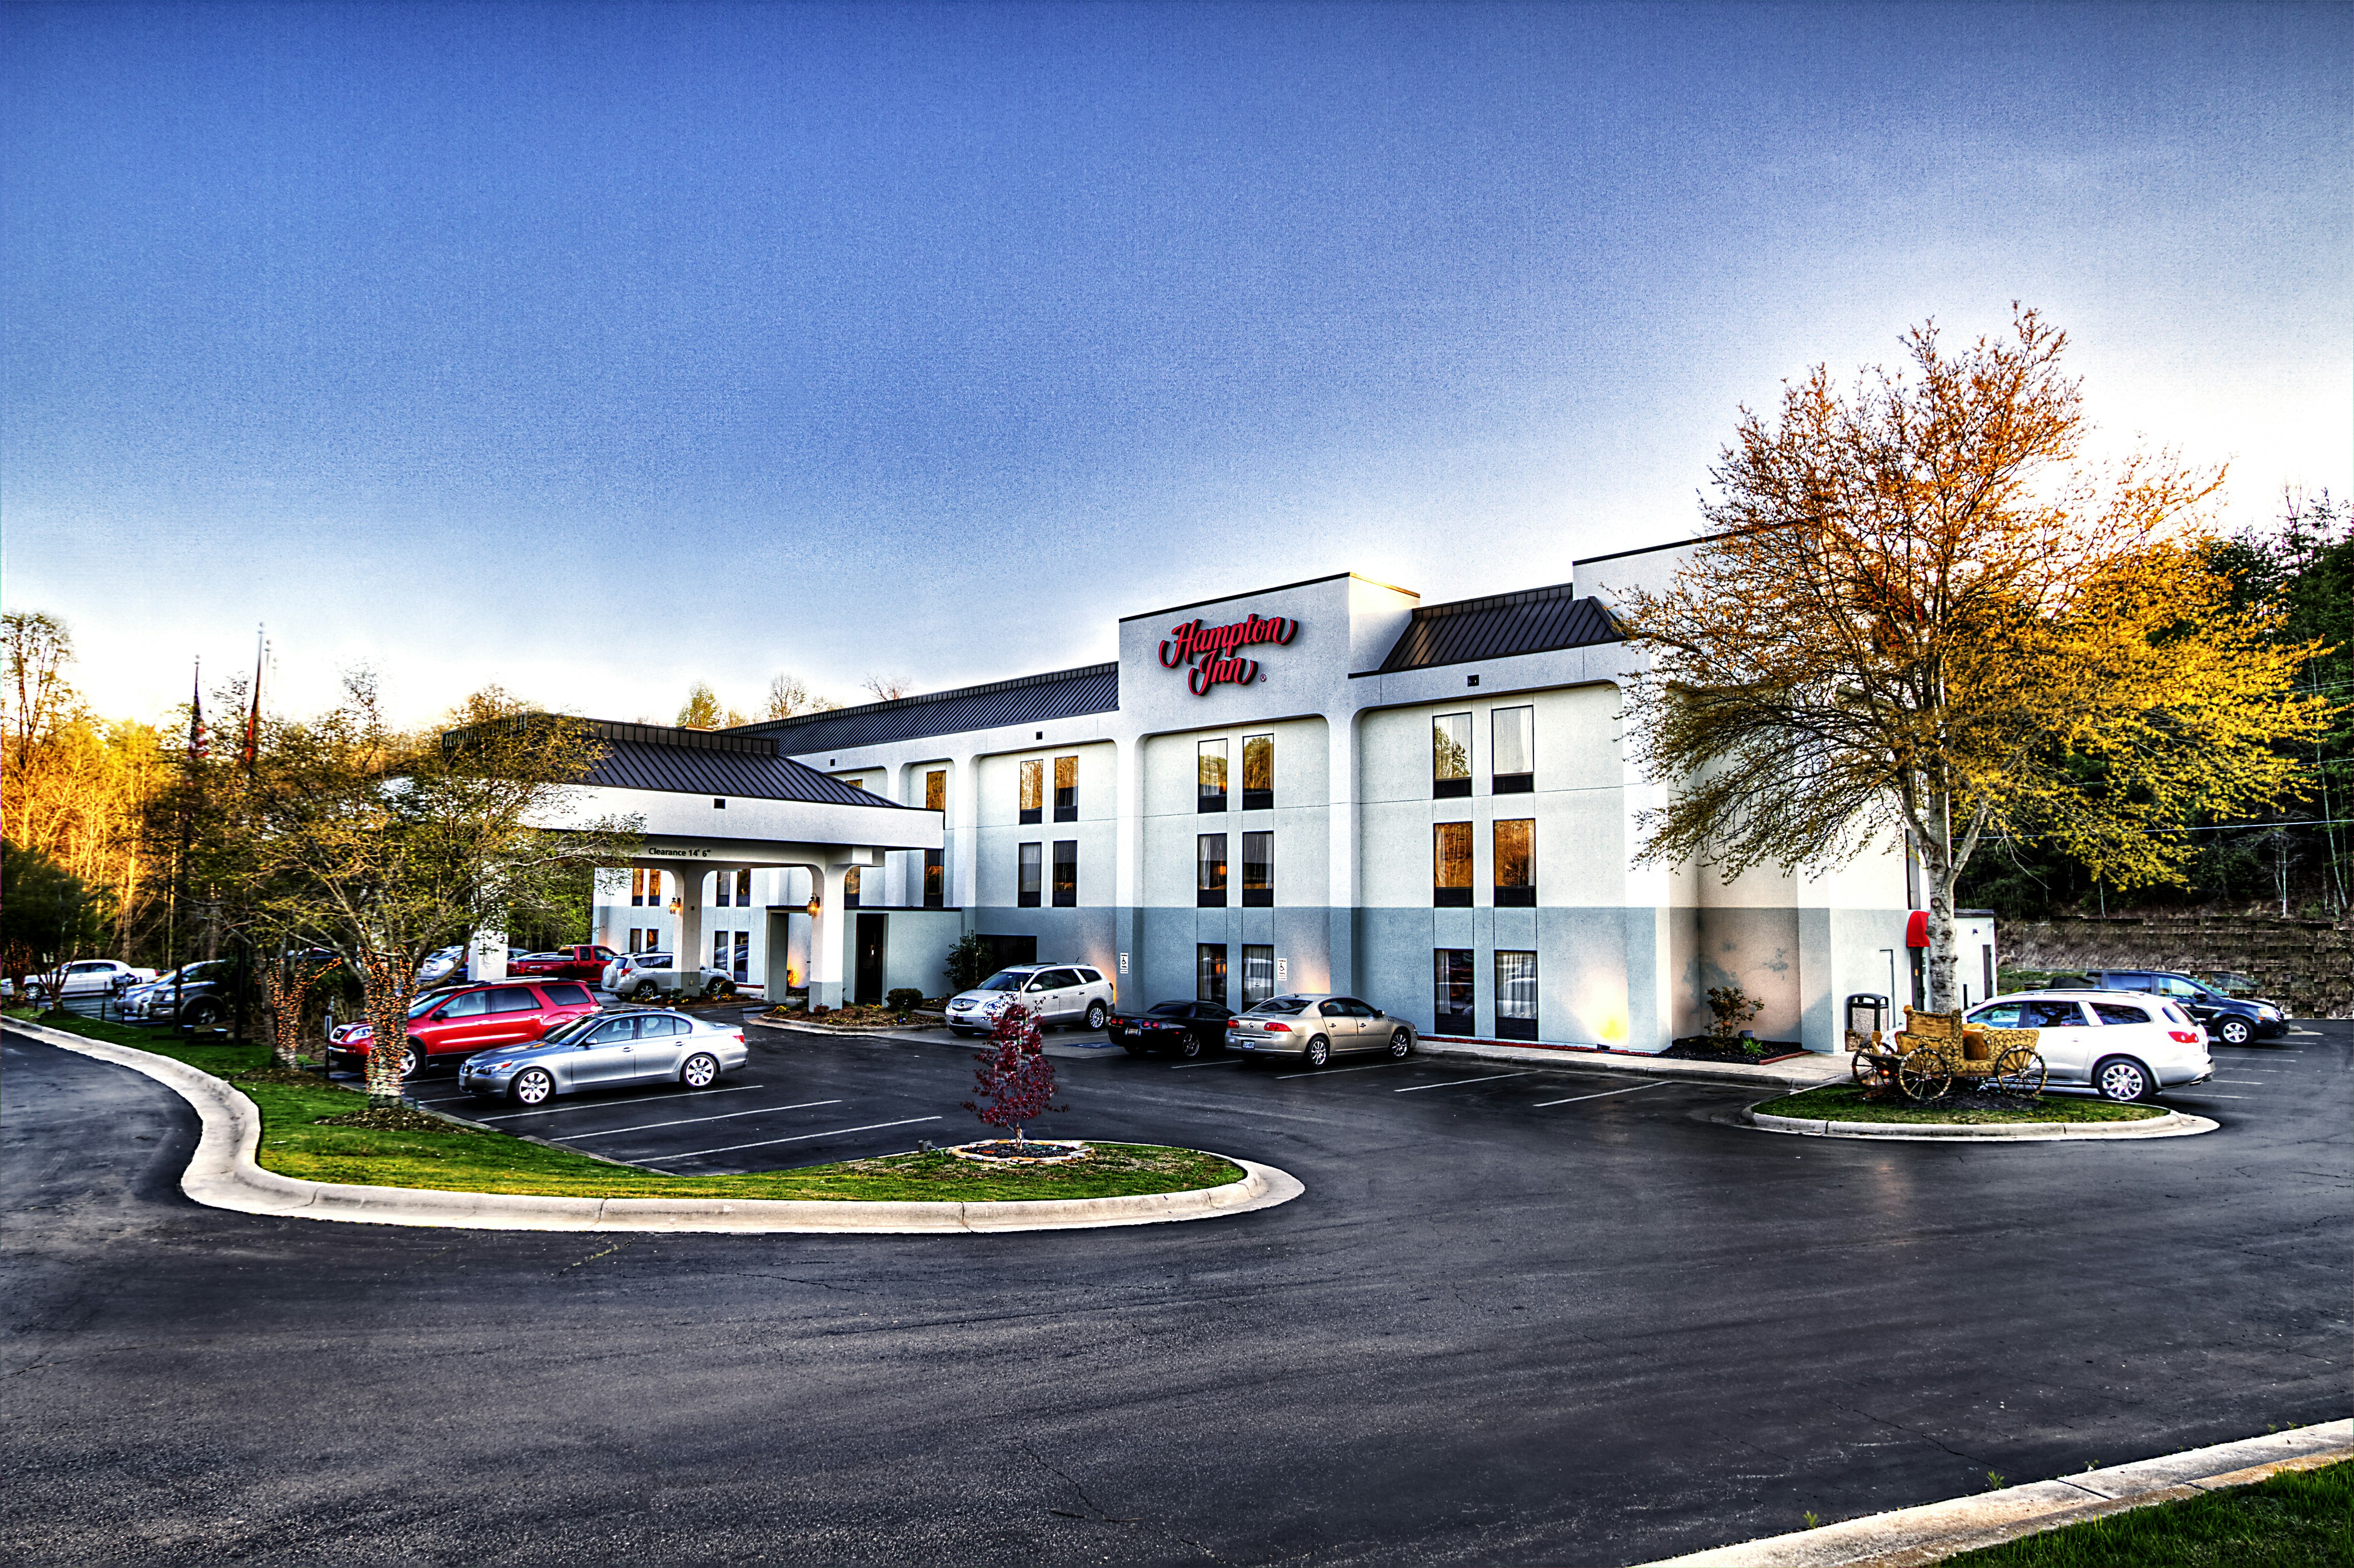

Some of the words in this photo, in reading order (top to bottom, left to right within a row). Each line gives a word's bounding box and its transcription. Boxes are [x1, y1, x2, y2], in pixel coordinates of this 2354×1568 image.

[1159, 614, 1298, 668] Hampton
[1188, 650, 1259, 696] Inn
[649, 848, 686, 856] Clearance
